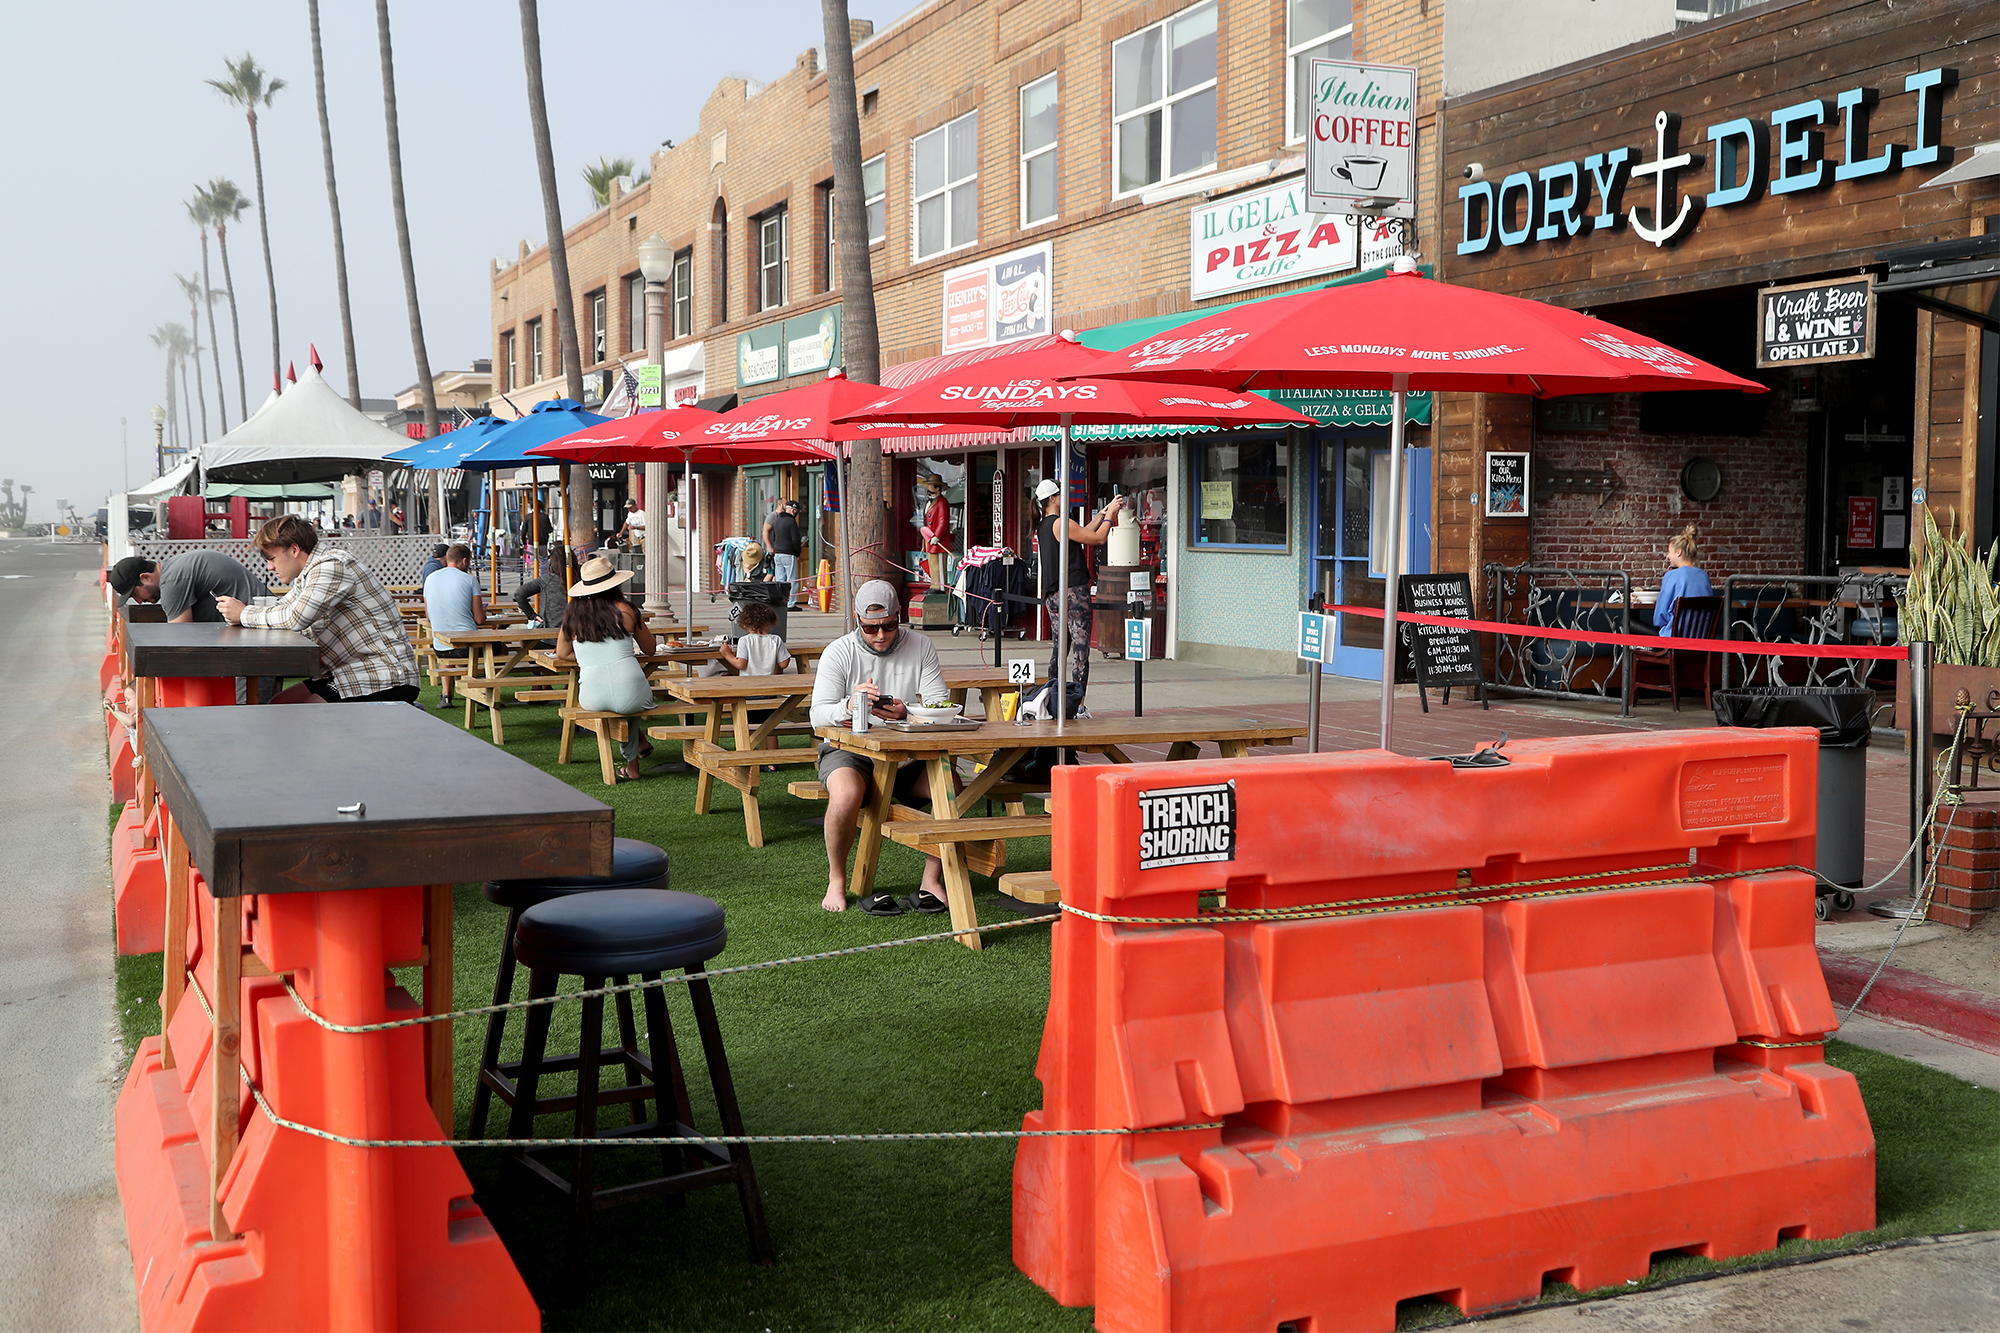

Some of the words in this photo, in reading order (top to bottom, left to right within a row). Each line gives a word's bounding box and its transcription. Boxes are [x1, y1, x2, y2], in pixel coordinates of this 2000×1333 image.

[1314, 76, 1411, 111] Italian
[1314, 114, 1412, 148] COFFEE
[1457, 146, 1630, 256] DORY
[1706, 67, 1943, 208] DELI
[1228, 186, 1307, 232] GELA
[1262, 223, 1278, 237] &
[1206, 221, 1341, 273] PIZZA
[1363, 252, 1371, 264] BY
[1372, 248, 1384, 262] THE
[1385, 244, 1402, 258] SLICE
[948, 284, 987, 309] HENRY'S
[1777, 291, 1822, 321] Craft
[1824, 287, 1868, 313] Beer
[1777, 323, 1791, 342] &
[1795, 316, 1851, 340] WINE
[1304, 345, 1339, 357] LESS
[1340, 344, 1407, 356] MONDAYS
[1410, 350, 1450, 360] MORE
[1770, 344, 1809, 361] OPEN
[1812, 340, 1848, 357] LATE
[641, 386, 659, 395] 9721
[940, 386, 1098, 400] SUNDAYS
[1280, 390, 1333, 399] ITALIAN
[979, 398, 1044, 412] Tequila
[1301, 405, 1339, 417] PIZZA
[1342, 405, 1351, 416] &
[1355, 403, 1406, 416] GELAT
[1557, 403, 1595, 423] EAT
[406, 423, 432, 438] URBA
[1031, 425, 1063, 436] ITALIA
[1074, 424, 1116, 435] STREET
[1411, 583, 1436, 597] WE'RE
[1414, 598, 1443, 607] BUSINESS
[1417, 625, 1447, 636] KITCHEN
[1013, 663, 1031, 679] 24
[1138, 792, 1230, 830] TRENCH
[1139, 824, 1230, 859] SHORING
[1146, 854, 1222, 868] COMPANY
